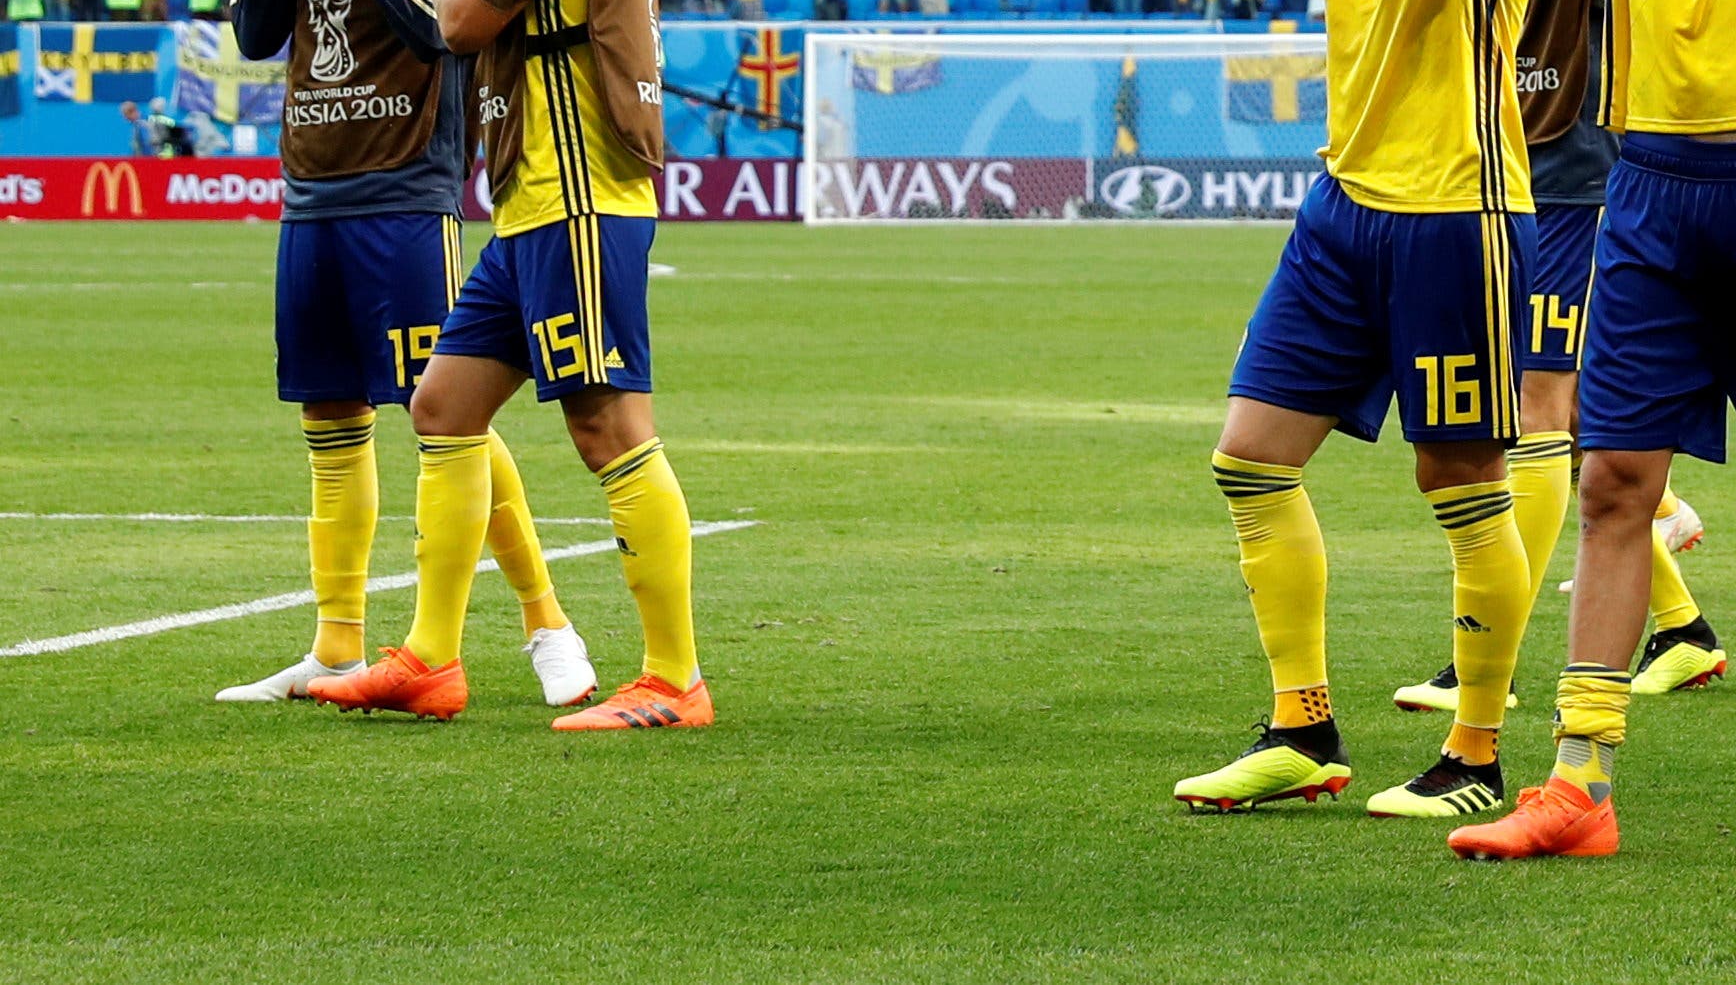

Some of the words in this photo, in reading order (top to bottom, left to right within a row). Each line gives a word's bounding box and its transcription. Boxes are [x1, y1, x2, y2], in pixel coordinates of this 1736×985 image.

[312, 86, 353, 101] WORLD
[353, 84, 376, 96] CUP
[1516, 68, 1560, 92] 2018
[350, 94, 413, 121] 2018
[723, 162, 1016, 216] AIRWAYS
[1200, 171, 1319, 210] HYU
[532, 313, 586, 383] 15
[1529, 294, 1579, 355] 14
[387, 325, 441, 388] 19
[1415, 353, 1481, 427] 16
